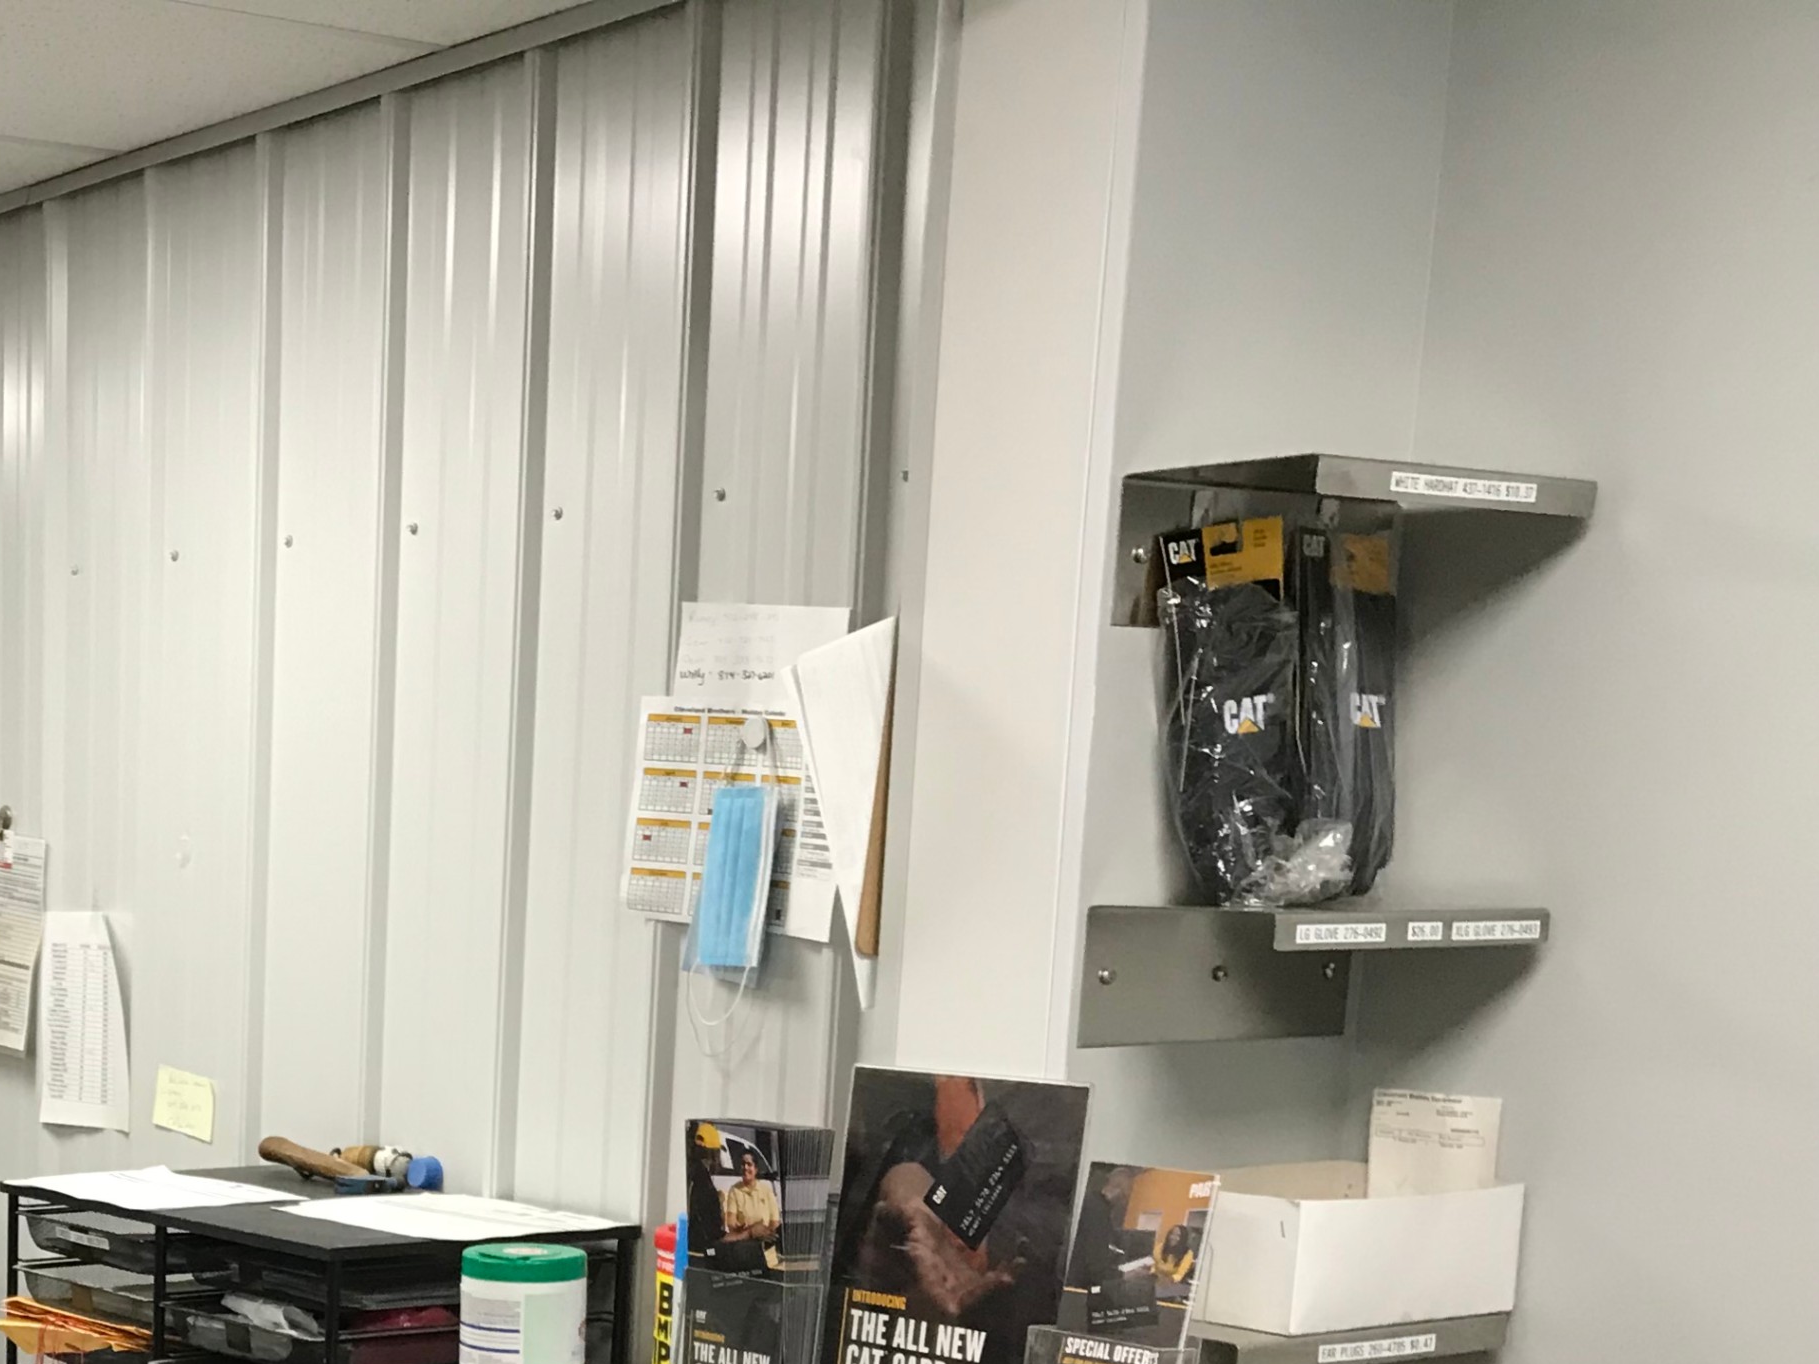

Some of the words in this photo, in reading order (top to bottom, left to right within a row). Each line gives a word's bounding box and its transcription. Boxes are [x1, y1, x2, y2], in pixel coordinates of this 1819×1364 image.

[1169, 539, 1198, 565] CAT
[1303, 535, 1327, 558] CAT
[1222, 694, 1271, 735] CAT
[1349, 692, 1385, 728] CAT
[1314, 927, 1339, 940] GLOVE
[1473, 924, 1496, 937] GLOVE
[851, 1308, 890, 1346] THE
[892, 1317, 930, 1354] ALL
[936, 1324, 987, 1364] NEW
[694, 1342, 716, 1364] THE
[1065, 1337, 1111, 1361] SPECIAL
[1322, 1348, 1337, 1359] EAR
[1340, 1345, 1365, 1358] PLUGS
